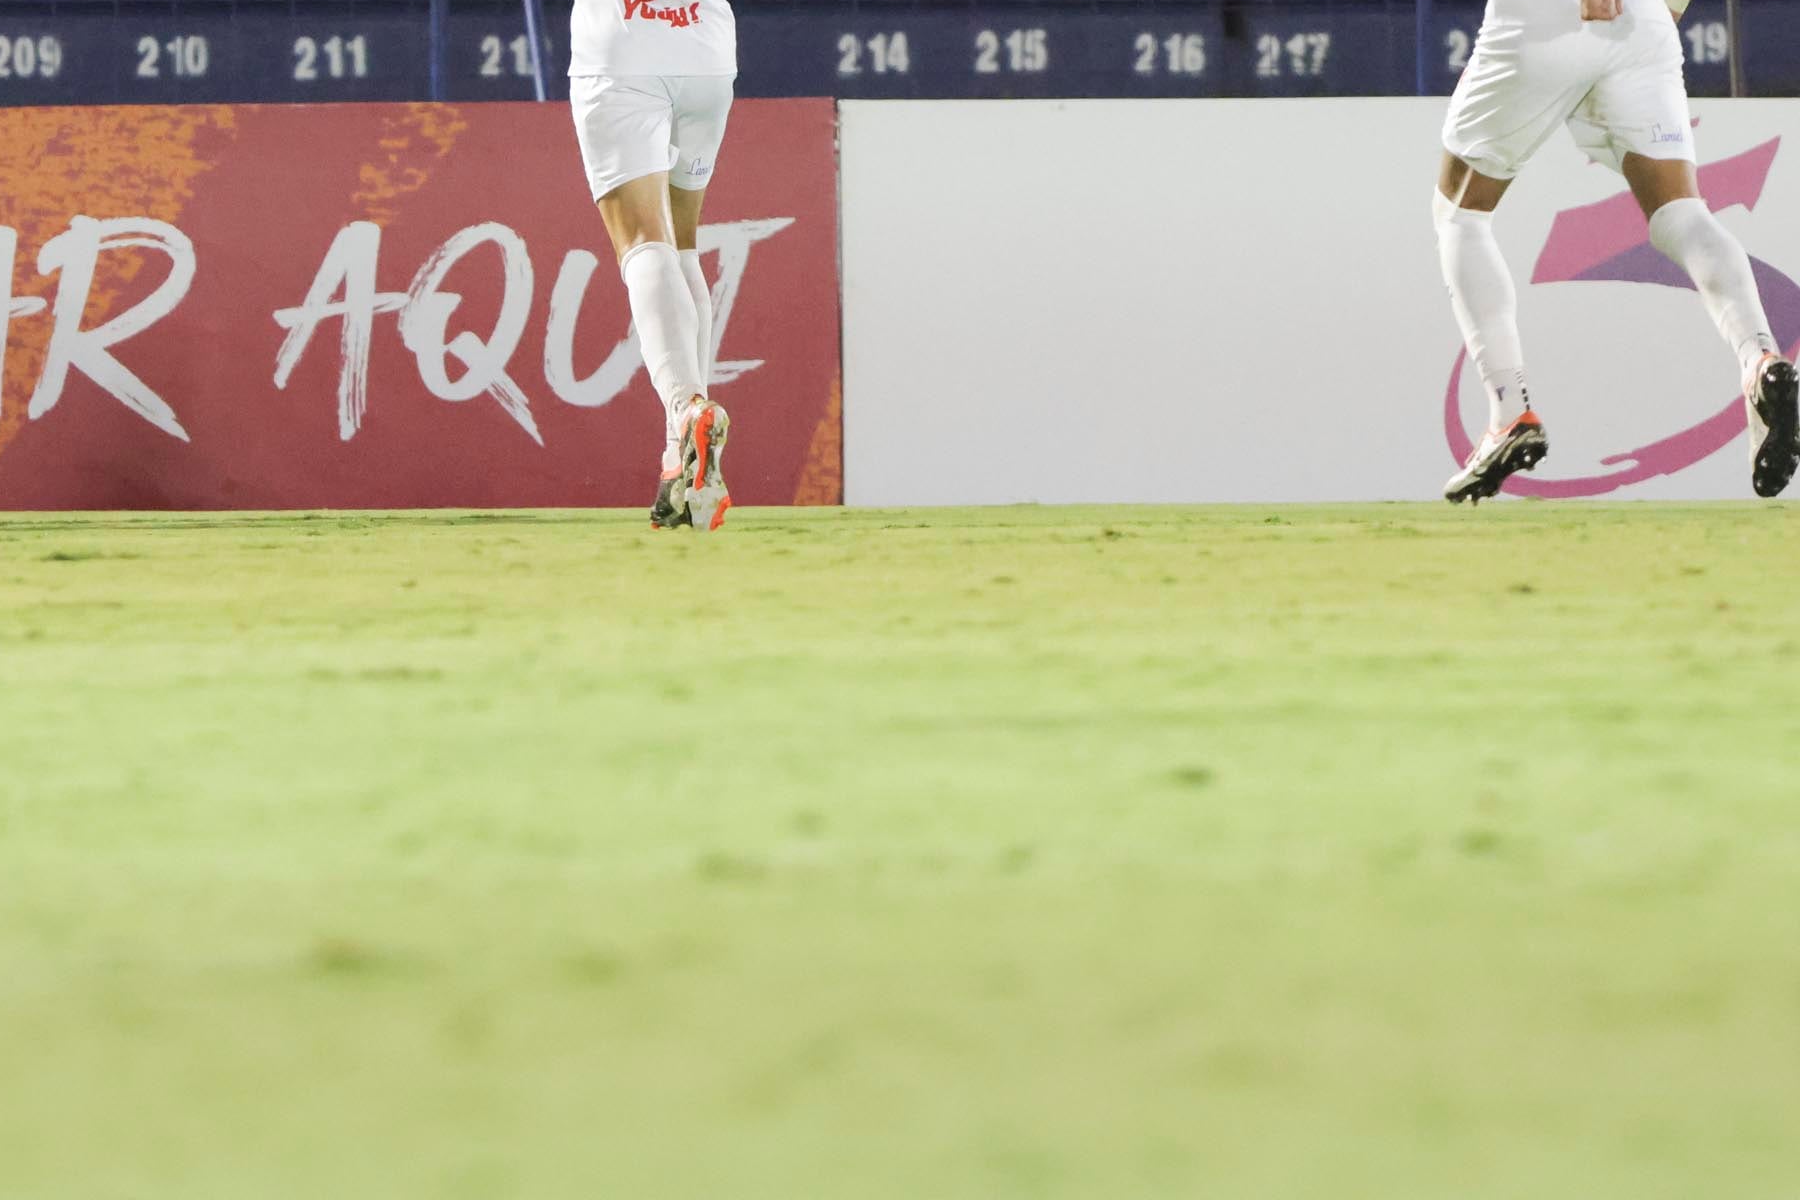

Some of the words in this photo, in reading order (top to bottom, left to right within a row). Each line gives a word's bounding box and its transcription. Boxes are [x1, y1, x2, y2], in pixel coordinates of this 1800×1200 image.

[136, 35, 208, 77] 210
[293, 35, 367, 80] 211
[975, 28, 1049, 73] 215
[1134, 32, 1206, 74] 216
